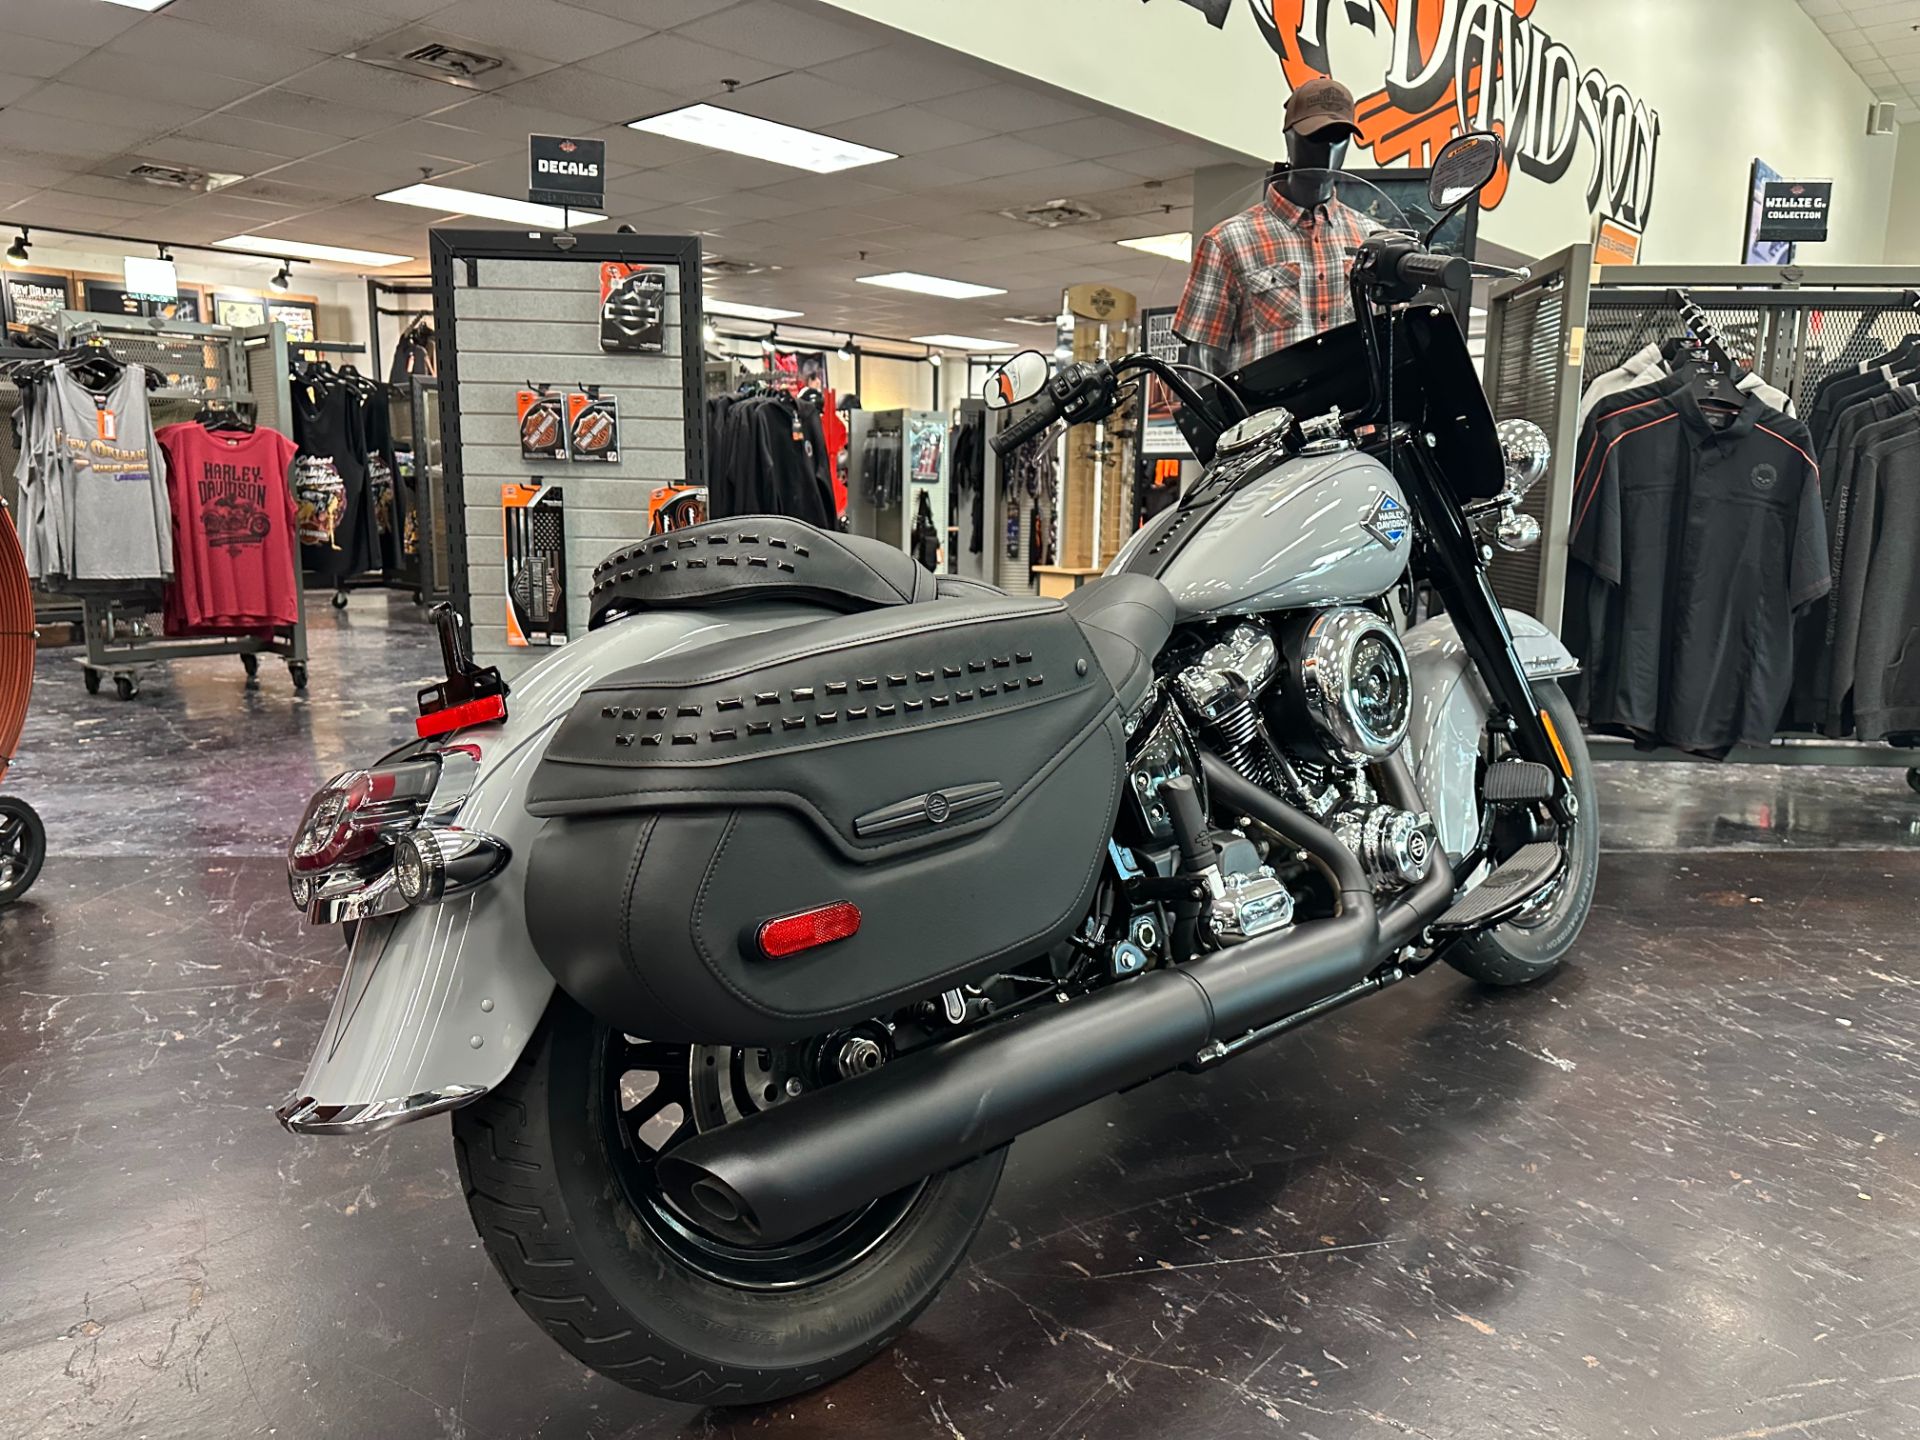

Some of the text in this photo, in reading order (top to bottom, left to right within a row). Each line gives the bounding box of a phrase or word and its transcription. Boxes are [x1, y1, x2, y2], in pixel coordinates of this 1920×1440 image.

[538, 159, 598, 177] DECALS
[1765, 198, 1827, 208] WILLIE G.
[1767, 211, 1822, 219] COLLECTION
[198, 481, 266, 509] DAVIDSON
